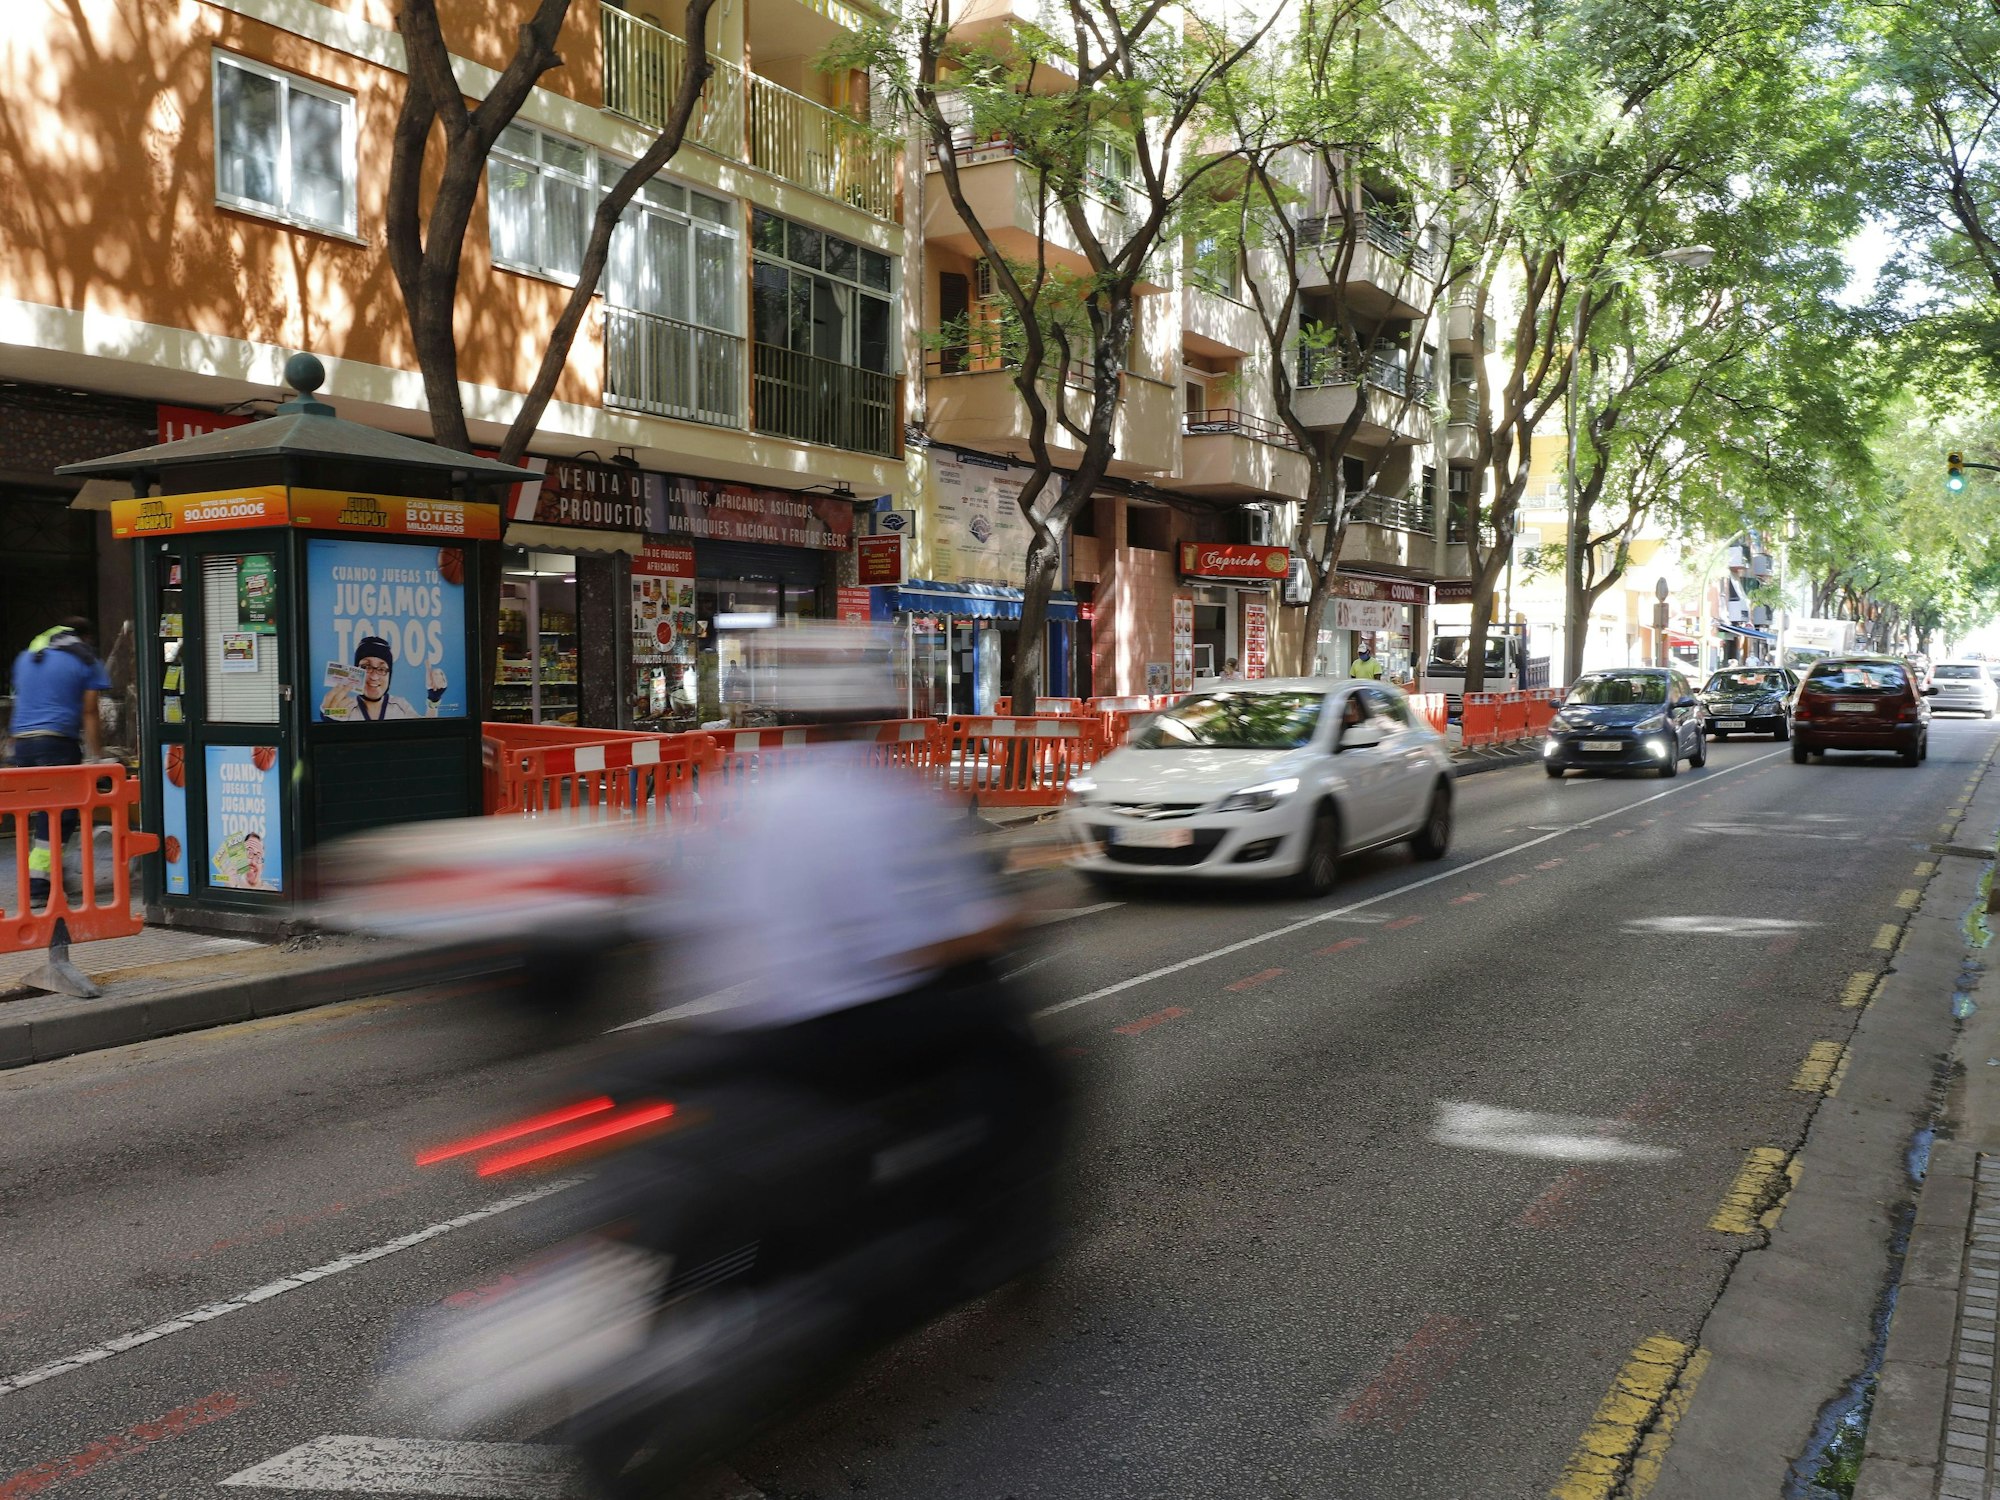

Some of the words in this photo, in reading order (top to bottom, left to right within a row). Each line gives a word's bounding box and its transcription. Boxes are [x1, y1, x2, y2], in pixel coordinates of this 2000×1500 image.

[559, 466, 619, 495] VENTA
[631, 476, 652, 499] DE
[184, 502, 265, 521] 90.000.000€
[347, 496, 377, 512] EURO
[406, 501, 428, 509] CADA
[430, 503, 464, 512] VIERNES
[560, 497, 652, 527] PRODUCTOS
[668, 487, 712, 508] LATINOS,
[715, 493, 767, 514] AFRICANOS,
[770, 499, 815, 520] ASIÁTICOS,
[338, 510, 388, 527] JACKPOT
[406, 509, 465, 524] BOTES
[406, 522, 465, 533] MILLONARIOS
[668, 515, 733, 537] MARROQUIES,
[735, 522, 779, 541] NACIONAL
[782, 528, 788, 540] Y
[789, 528, 820, 545] FRUTOS
[822, 533, 847, 548] SECOS
[651, 548, 660, 558] DE
[660, 549, 693, 561] PRODUCTOS
[1200, 550, 1263, 571] Capricho
[332, 566, 377, 581] CUANDO
[382, 568, 421, 583] JUEGAS
[646, 561, 680, 573] AFRICANOS
[333, 583, 442, 618] JUGAMOS
[1391, 584, 1415, 600] COTON
[1439, 587, 1472, 597] COTON
[219, 763, 265, 783] CUANDO
[222, 782, 249, 795] JUEGAS
[221, 796, 265, 814] JUGAMOS
[221, 814, 266, 839] TODOS
